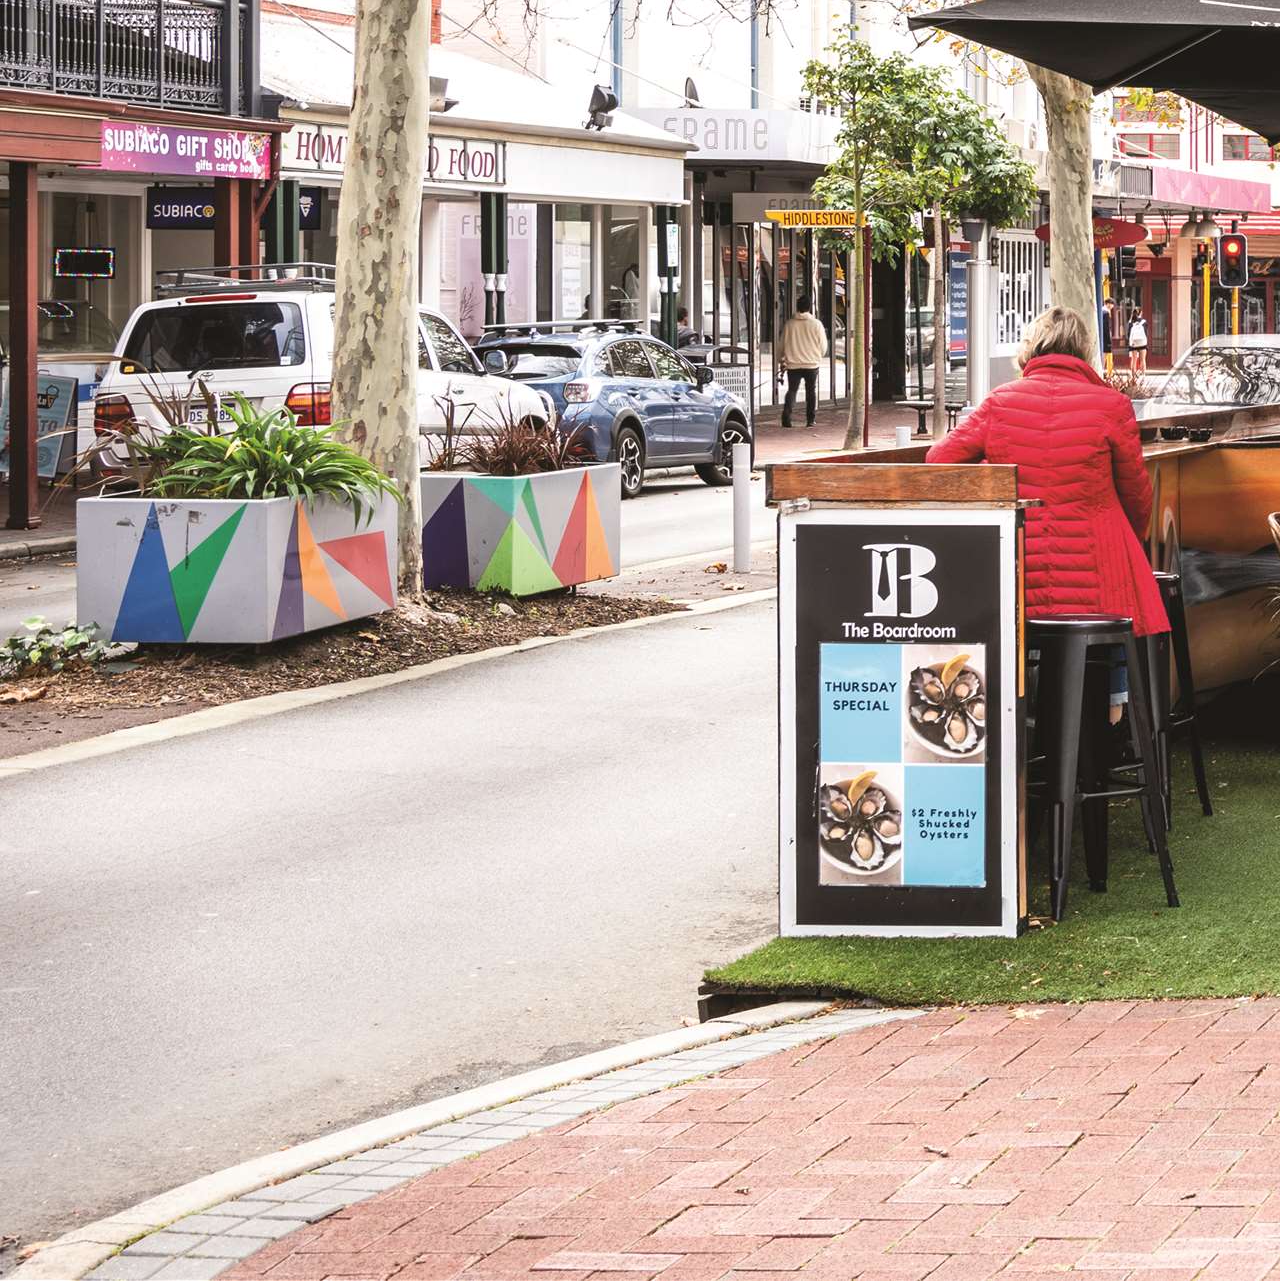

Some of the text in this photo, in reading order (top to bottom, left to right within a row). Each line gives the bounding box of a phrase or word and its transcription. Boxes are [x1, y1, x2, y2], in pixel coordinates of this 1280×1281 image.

[104, 128, 250, 160] SUBIACO GIFT SHOP
[296, 131, 349, 164] HOM
[195, 159, 212, 172] gifts
[448, 148, 495, 178] FOOD
[783, 212, 855, 226] HIDDLESTONE
[842, 622, 956, 638] The Boardroom
[825, 681, 898, 693] THURSDAY
[833, 700, 890, 711] SPECIAL
[911, 808, 977, 820] $2 Freshly
[919, 819, 970, 828] Shucked
[920, 830, 969, 841] Oysters
